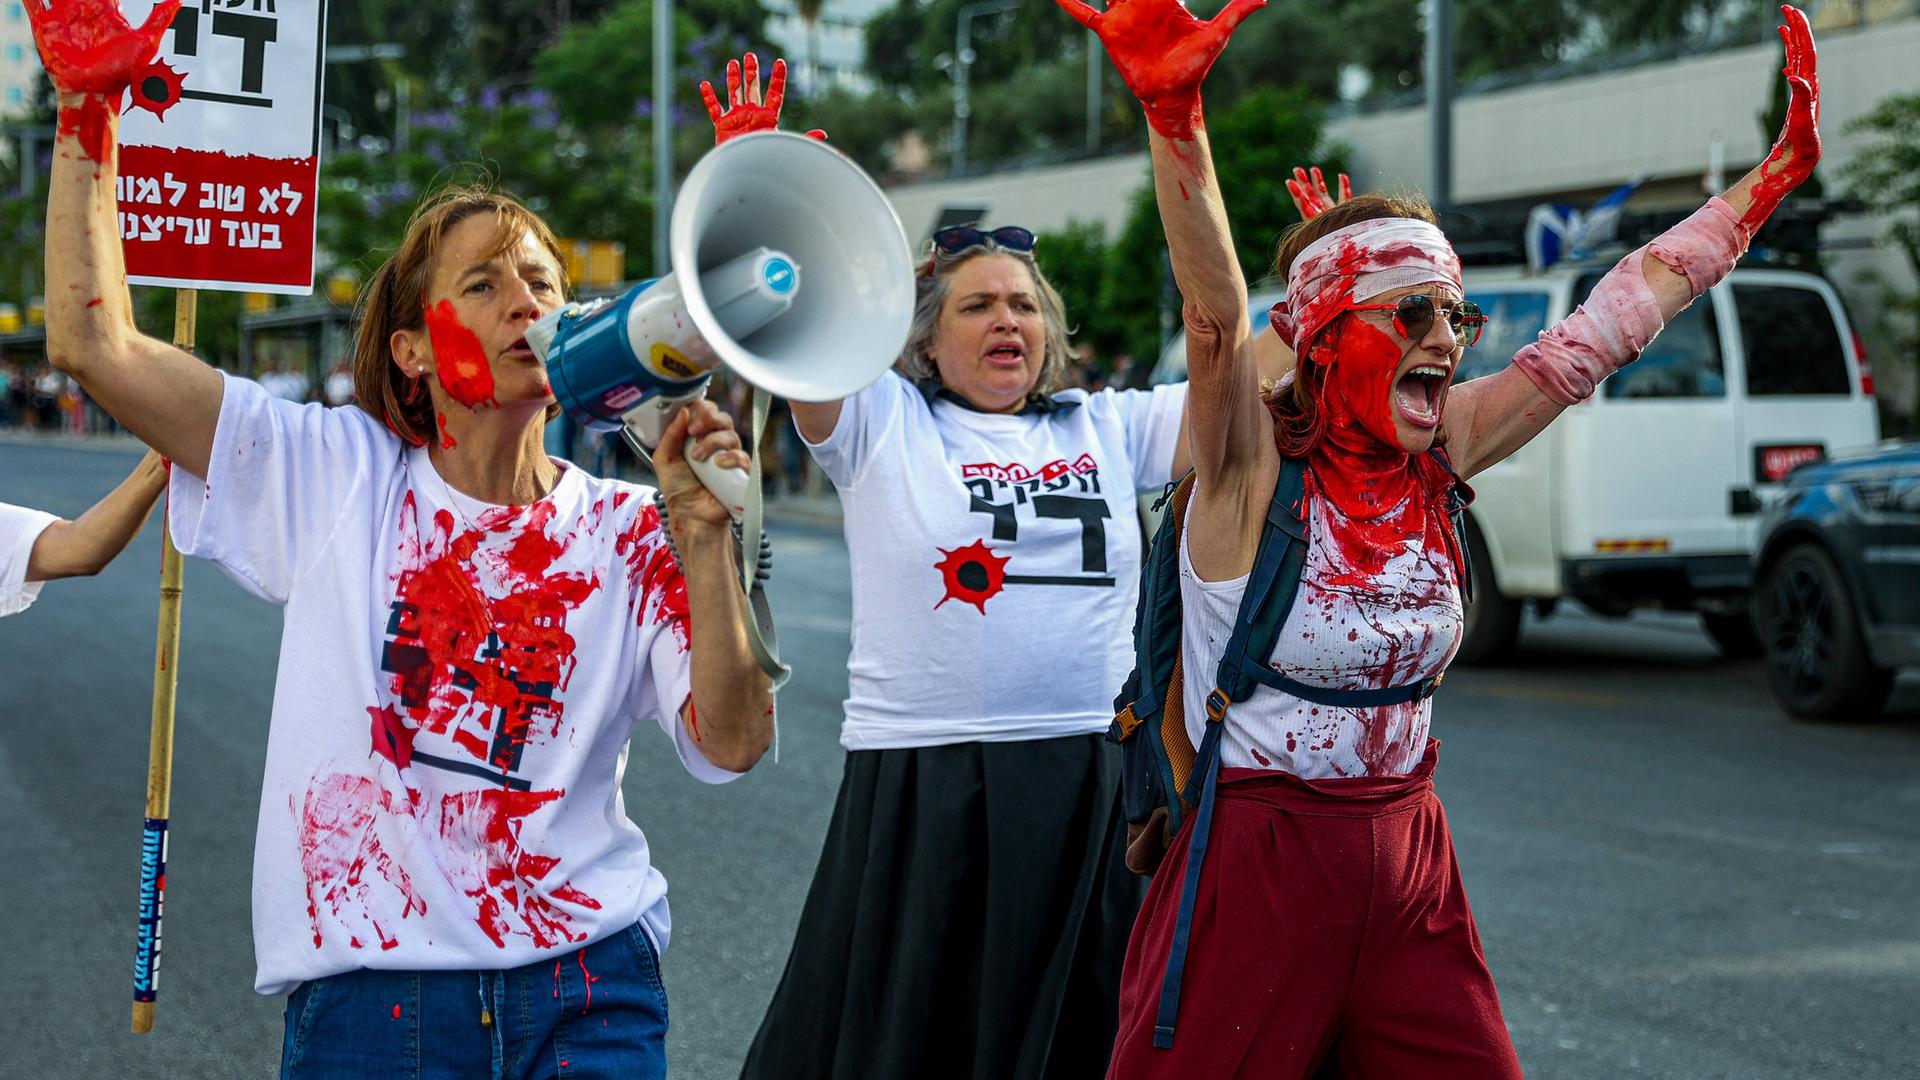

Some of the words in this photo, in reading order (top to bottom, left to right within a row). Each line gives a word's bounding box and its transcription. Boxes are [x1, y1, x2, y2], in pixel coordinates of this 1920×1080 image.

[199, 182, 246, 212] טוב
[258, 182, 303, 216] לא
[220, 219, 283, 250] בעד
[139, 828, 161, 920] העצמאות
[133, 922, 155, 992] למגילת
